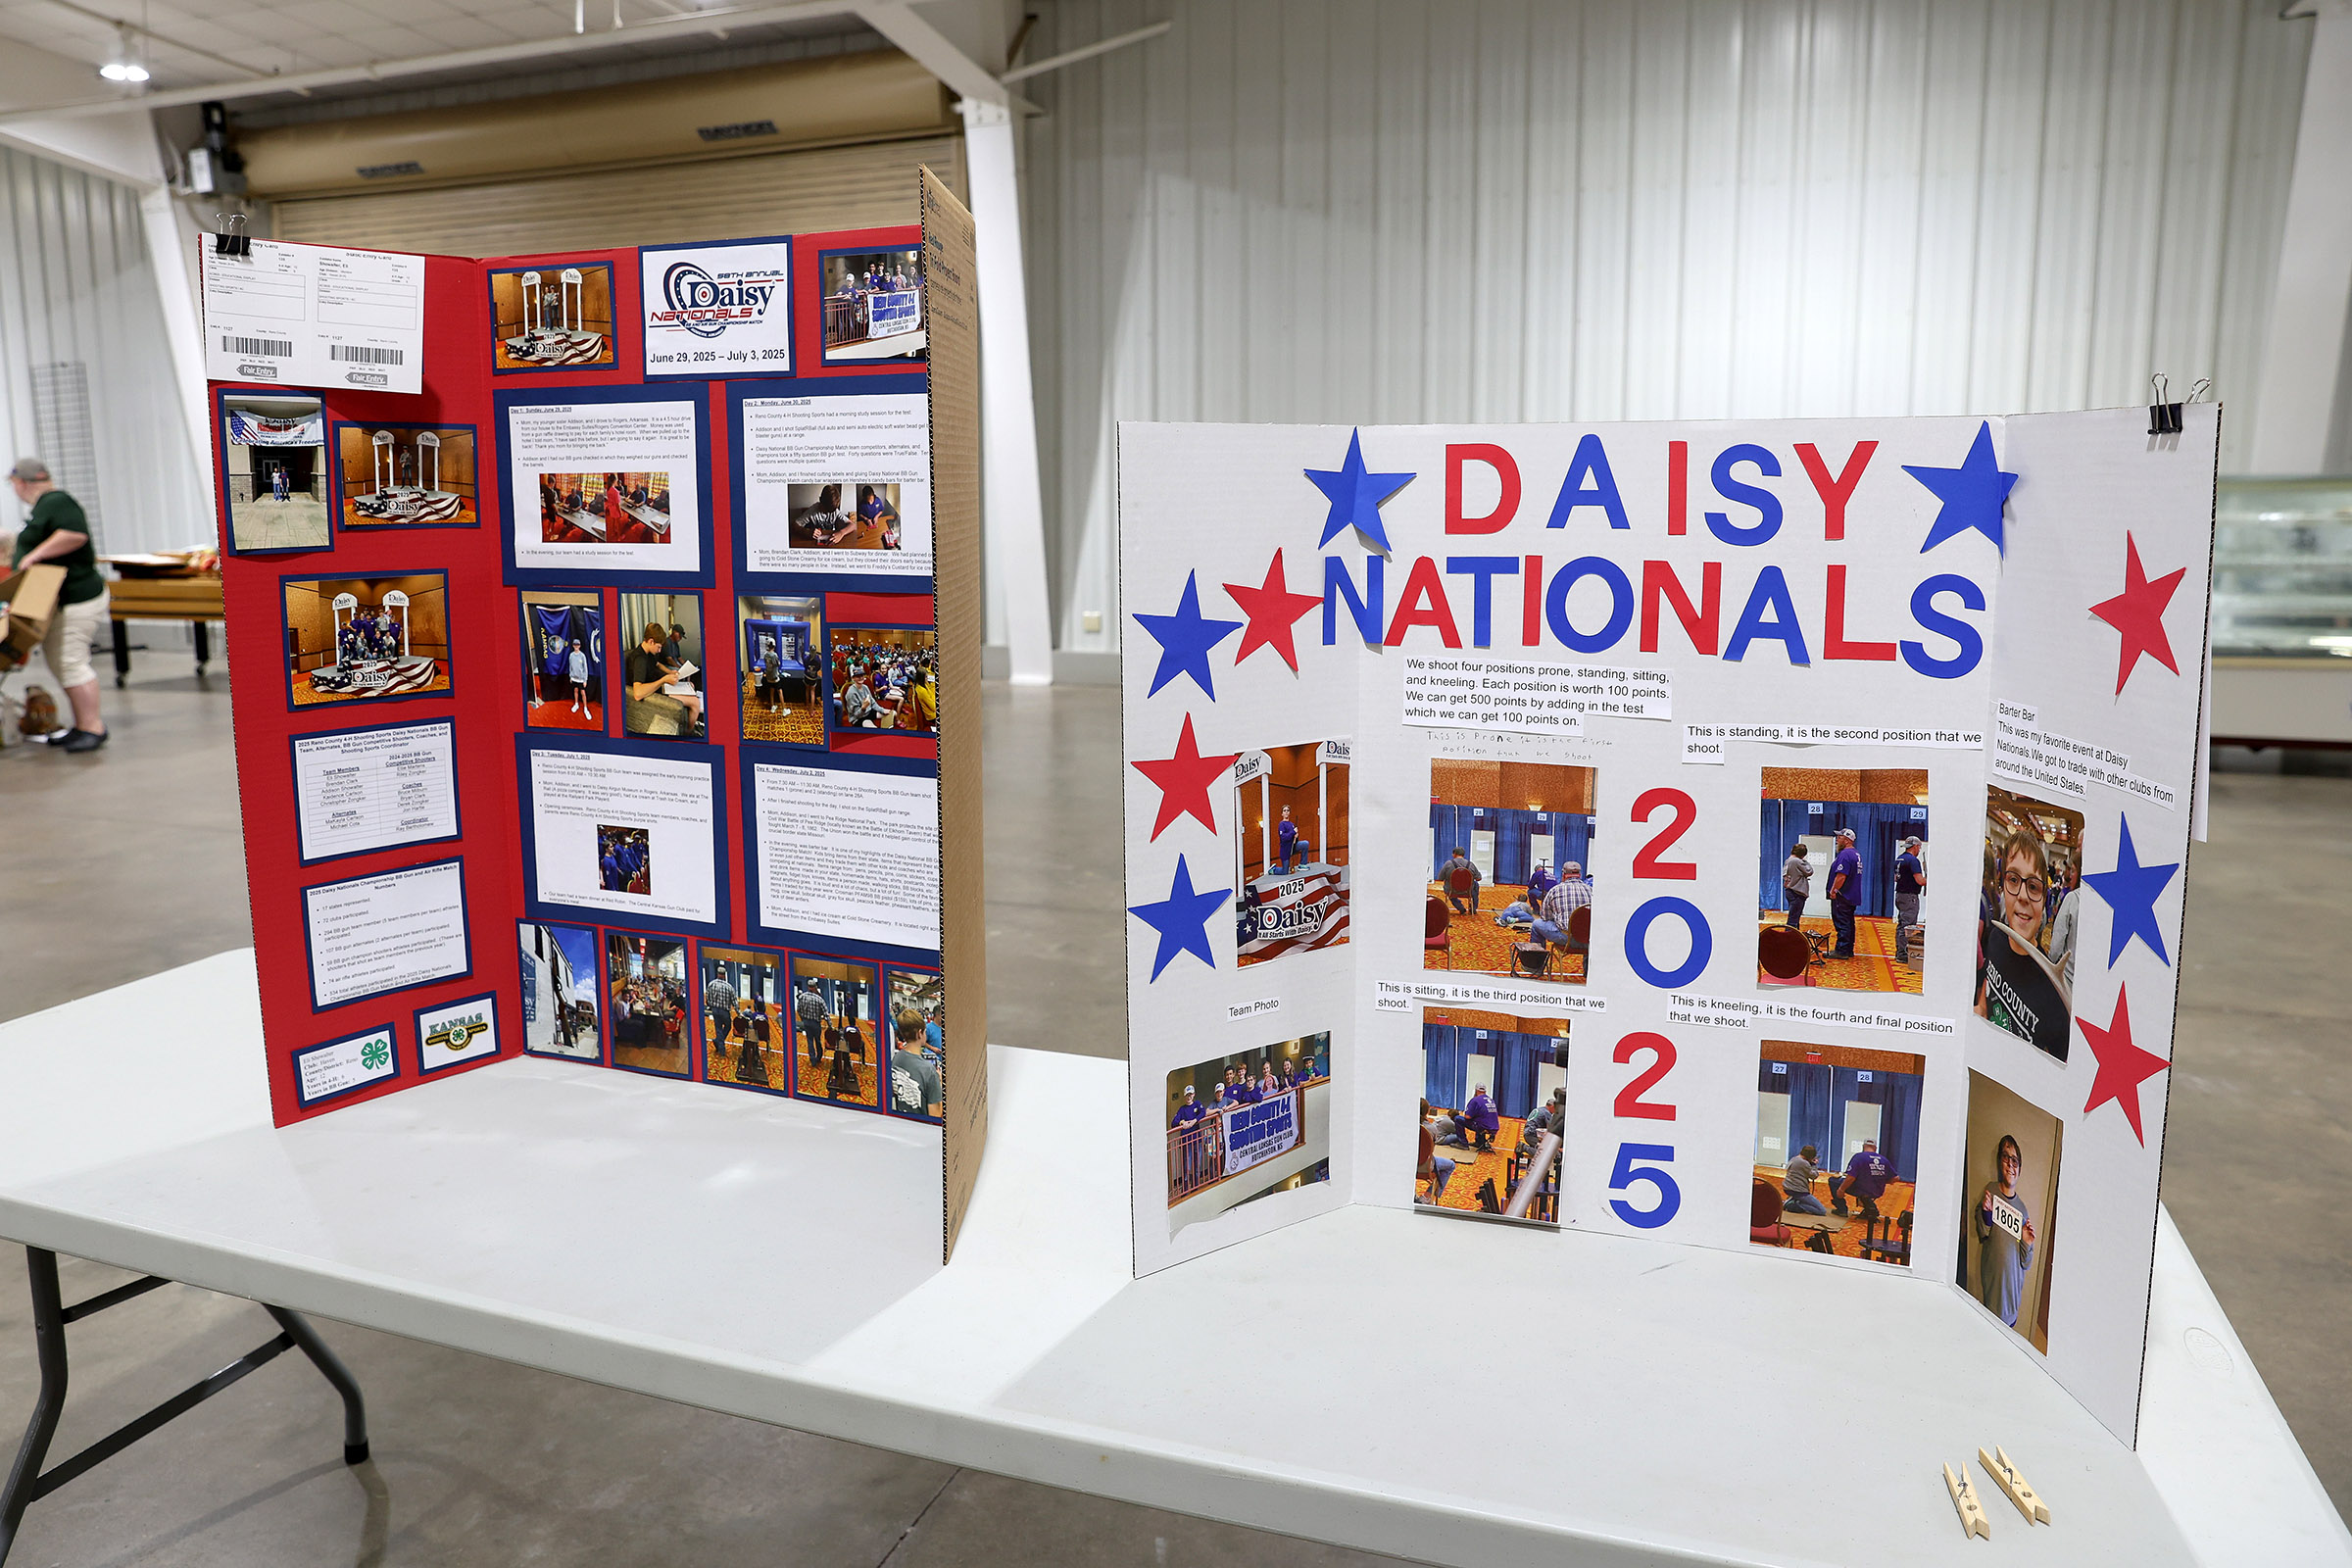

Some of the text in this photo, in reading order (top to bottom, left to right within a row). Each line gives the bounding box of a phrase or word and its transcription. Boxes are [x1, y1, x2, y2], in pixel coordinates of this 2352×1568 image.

[687, 279, 775, 315] Daisy
[651, 308, 753, 321] NATIONALS
[536, 343, 566, 353] Daisy
[650, 349, 785, 363] June 29, 2025 July 3, 2025
[1444, 433, 1879, 546] DAISY
[387, 500, 421, 511] Daisy
[1323, 555, 1986, 678] NATIONALS
[351, 670, 390, 682] Daisy
[1407, 659, 1669, 684] We shoot four positions prone, standing, sitting,
[1406, 675, 1669, 699] and kneeling. Each position is worth 100 points.
[1406, 691, 1643, 714] We can get 500 points by adding in the test
[1999, 703, 2035, 722] Barter Bar
[1405, 707, 1436, 718] which
[1458, 711, 1478, 720] can
[1481, 712, 1498, 723] get
[1503, 712, 1522, 722] 100
[1526, 714, 1559, 725] points
[1562, 718, 1579, 726] on.
[1427, 730, 1450, 740] This
[1475, 734, 1512, 743] Prone
[1687, 726, 1981, 742] This is standing, it is the second position that we
[1326, 740, 1350, 755] Dais
[1687, 743, 1722, 753] shoot.
[1999, 721, 2128, 770] This was my favorite event at Daisy
[1235, 754, 1261, 778] Daisy
[1995, 757, 2085, 795] around the United States.
[2045, 755, 2057, 768] got
[2059, 758, 2066, 768] to
[2068, 760, 2087, 776] trade
[2089, 766, 2104, 781] with
[2107, 772, 2127, 788] other
[2130, 778, 2151, 794] clubs
[2153, 786, 2173, 803] from
[1280, 880, 1304, 896] 2025
[1258, 901, 1327, 931] Daisy
[1378, 982, 1605, 1008] This is sitting, it is the third position that we
[1378, 998, 1409, 1009] shoot.
[1229, 999, 1279, 1017] Team Photo
[1671, 995, 1952, 1033] This is kneeling, it is the fourth and final position
[2002, 982, 2039, 1033] COUNTY
[429, 1013, 483, 1035] KANSAS
[1670, 1011, 1749, 1028] that we shoot.
[1995, 1206, 2019, 1233] 1805
